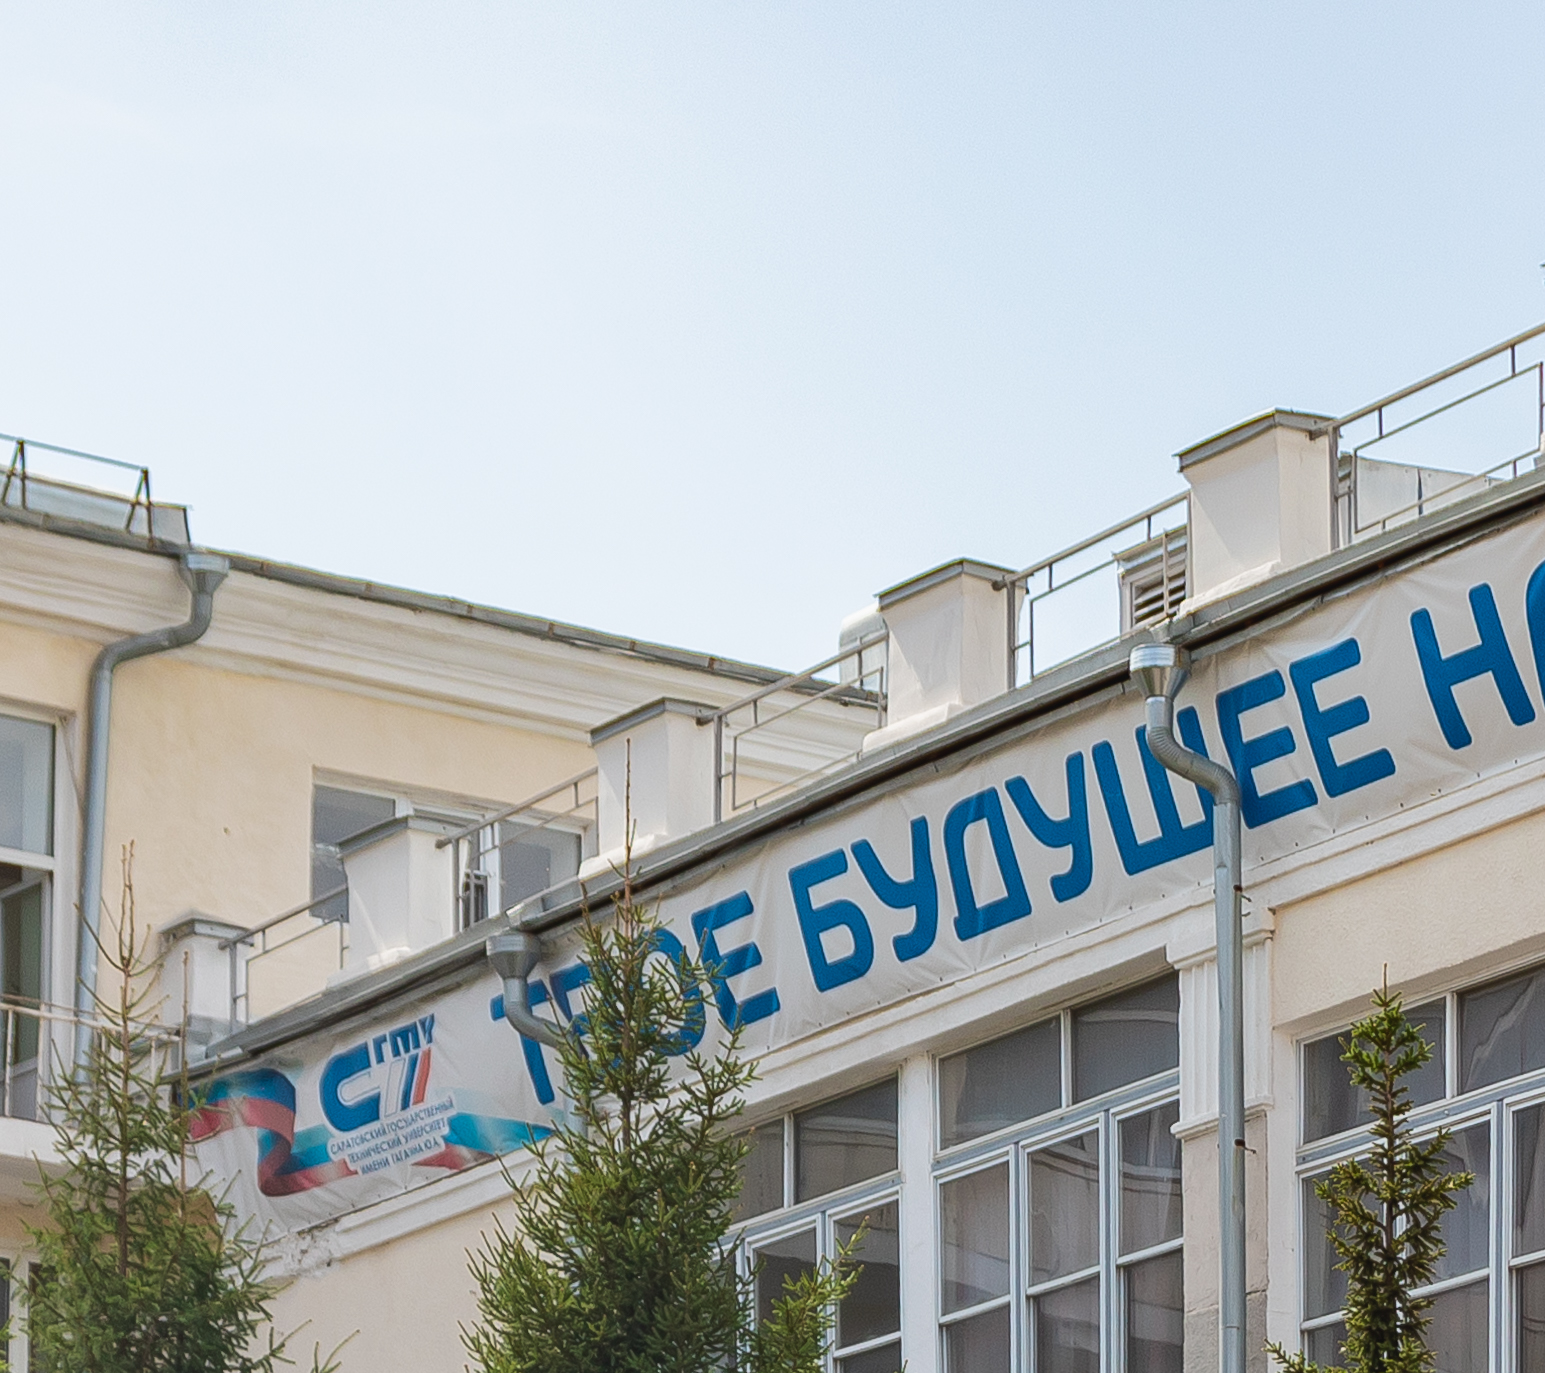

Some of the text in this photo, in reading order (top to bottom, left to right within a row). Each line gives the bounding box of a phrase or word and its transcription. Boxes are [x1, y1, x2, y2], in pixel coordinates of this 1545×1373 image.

[330, 1123, 387, 1155] САРАТОВСКИЙ
[348, 1117, 446, 1164] ТЕХНИЧЕСКИЙ УНИВЕРСИТЕТ
[360, 1157, 391, 1175] ИМЕНИ
